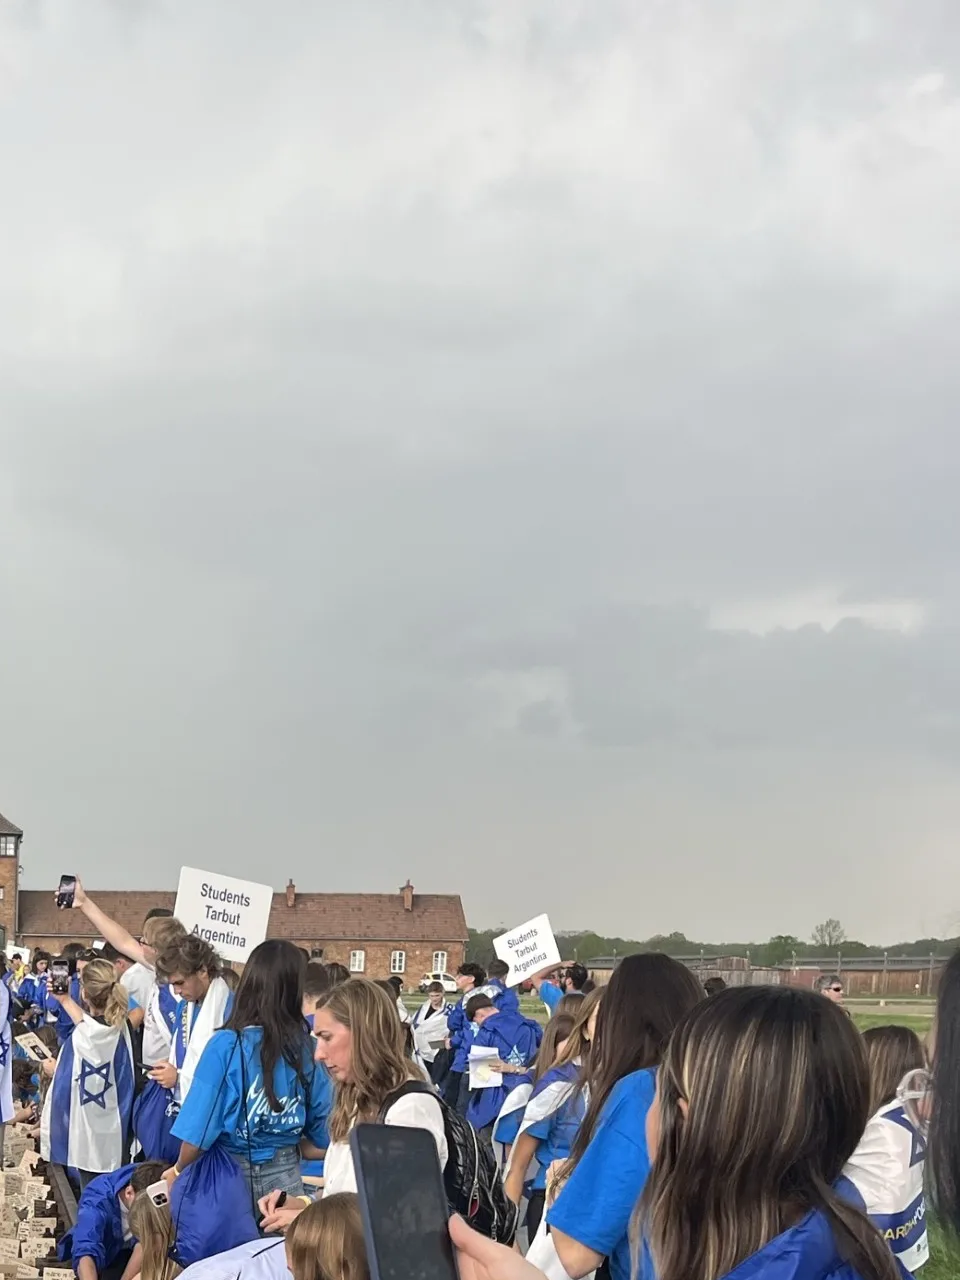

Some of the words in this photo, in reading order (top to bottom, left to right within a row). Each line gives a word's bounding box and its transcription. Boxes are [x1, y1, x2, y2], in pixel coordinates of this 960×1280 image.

[201, 883, 250, 907] Students
[206, 905, 240, 926] Tarbut
[192, 924, 246, 947] Argentina
[507, 929, 538, 948] Students
[515, 942, 538, 958] Tarbut
[514, 952, 547, 973] Argentina
